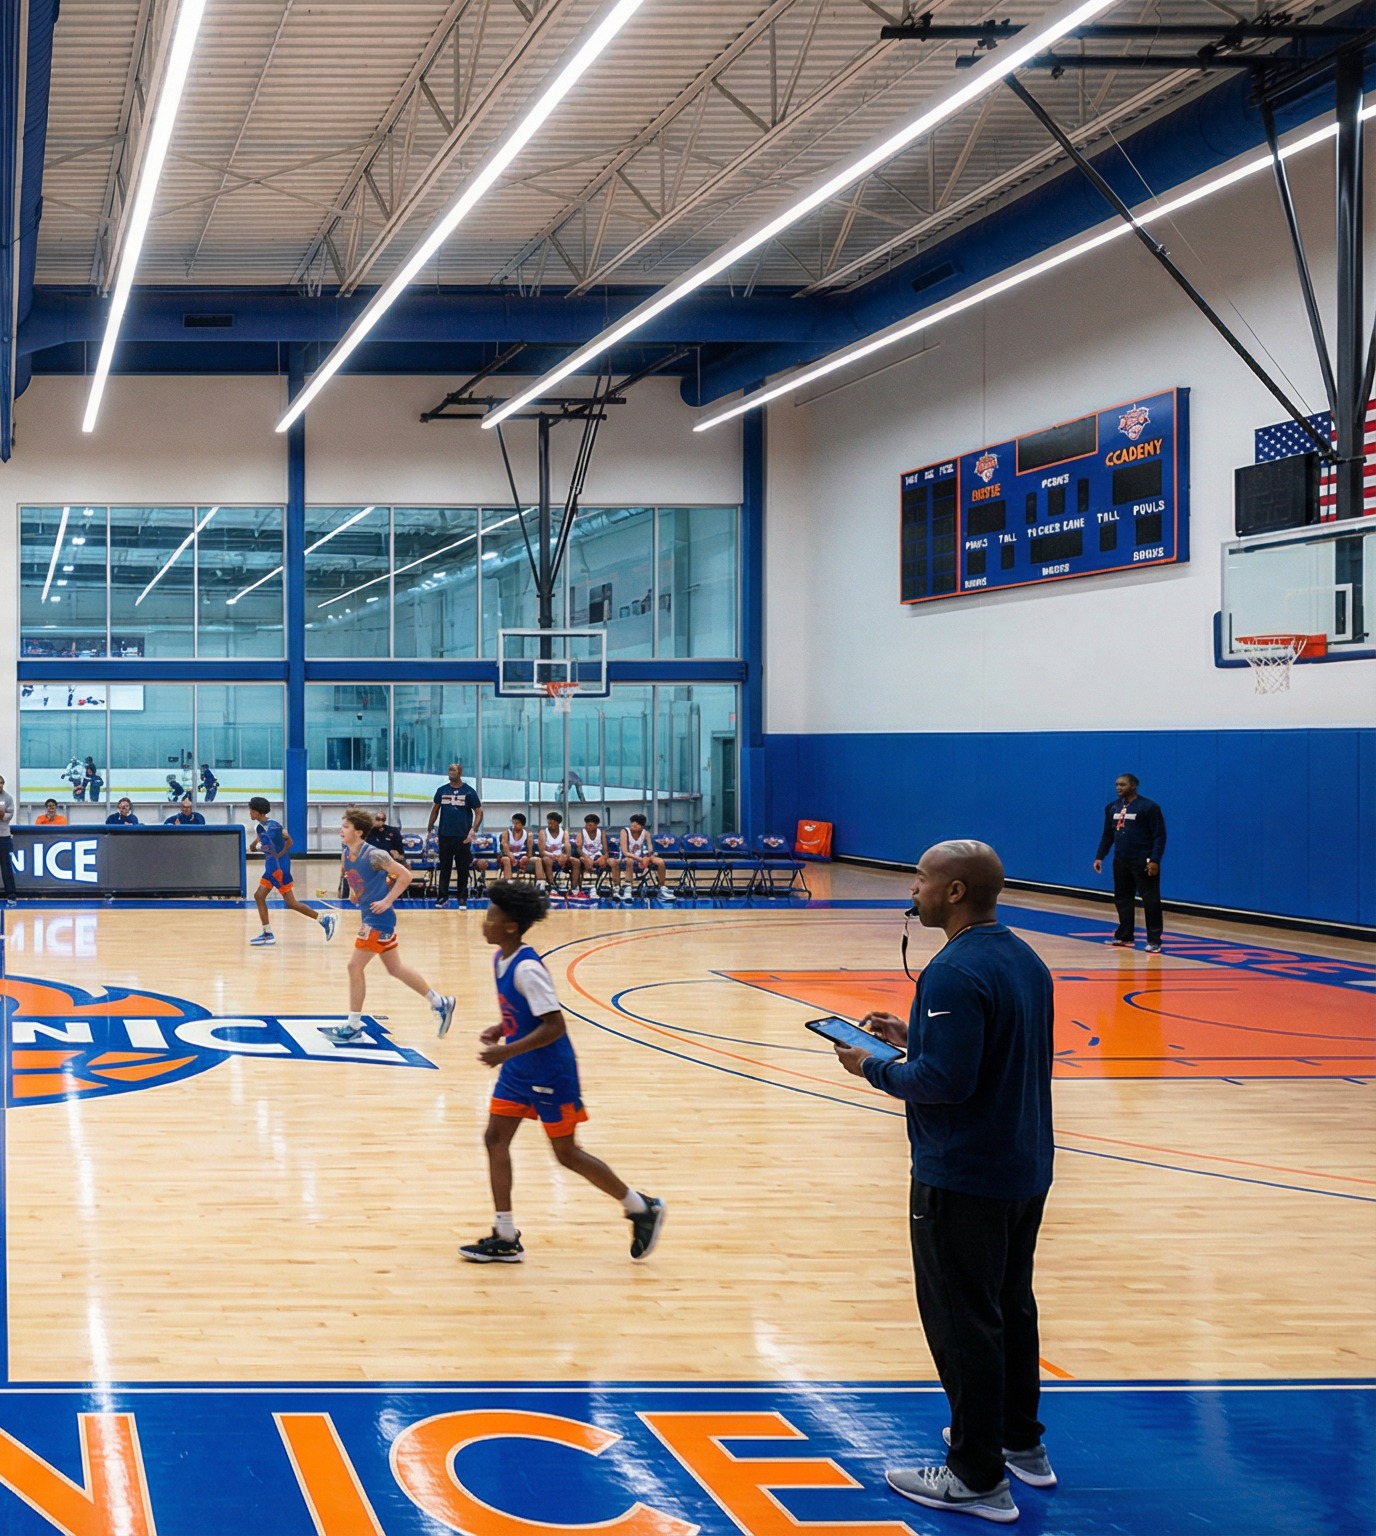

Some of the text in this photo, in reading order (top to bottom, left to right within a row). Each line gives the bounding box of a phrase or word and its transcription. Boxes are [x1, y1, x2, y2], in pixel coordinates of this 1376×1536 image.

[34, 839, 98, 883] ICE
[12, 1021, 94, 1044] N
[123, 1019, 409, 1064] ICE
[271, 1408, 924, 1536] ICE
